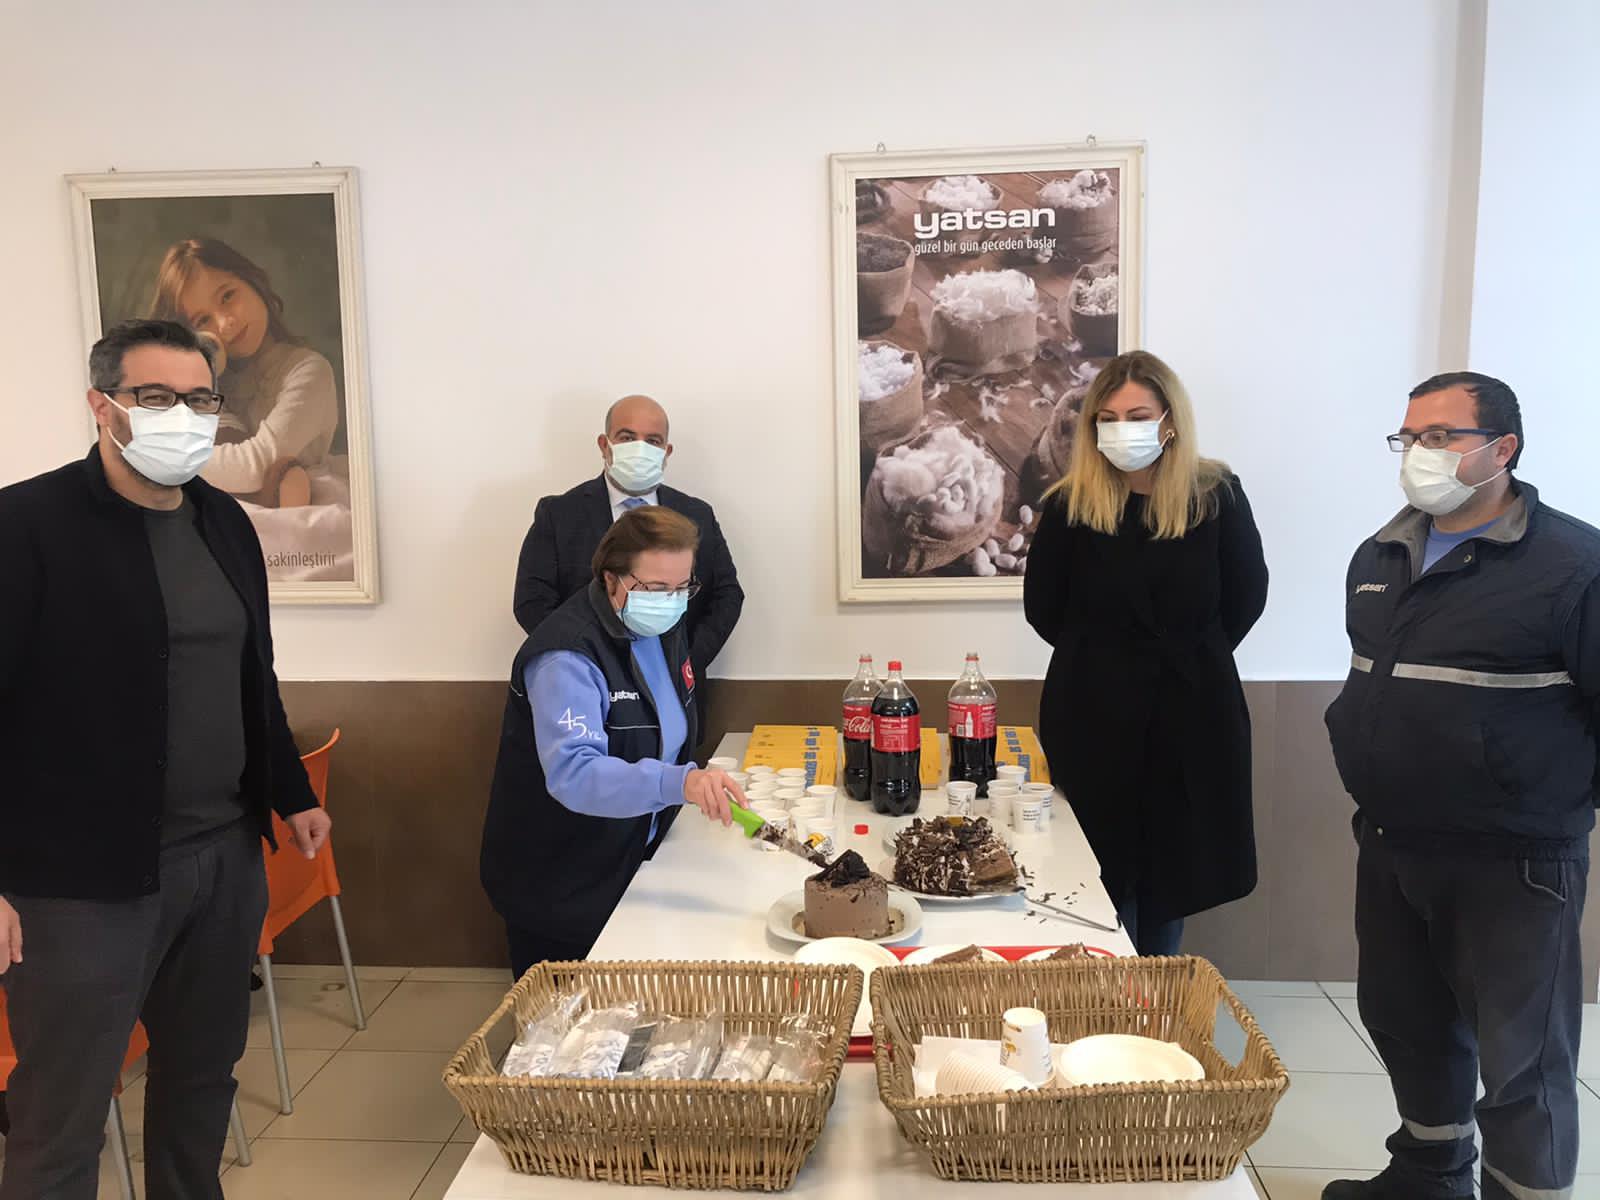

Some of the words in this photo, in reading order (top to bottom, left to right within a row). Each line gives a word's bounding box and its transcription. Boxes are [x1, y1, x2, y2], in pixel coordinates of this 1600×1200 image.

[913, 207, 1056, 239] yatsan
[914, 240, 941, 256] güzel
[943, 238, 957, 253] bir
[960, 239, 979, 254] gün
[982, 237, 1024, 253] geceden
[1026, 236, 1057, 251] başlar
[267, 551, 337, 568] sakinleştirir
